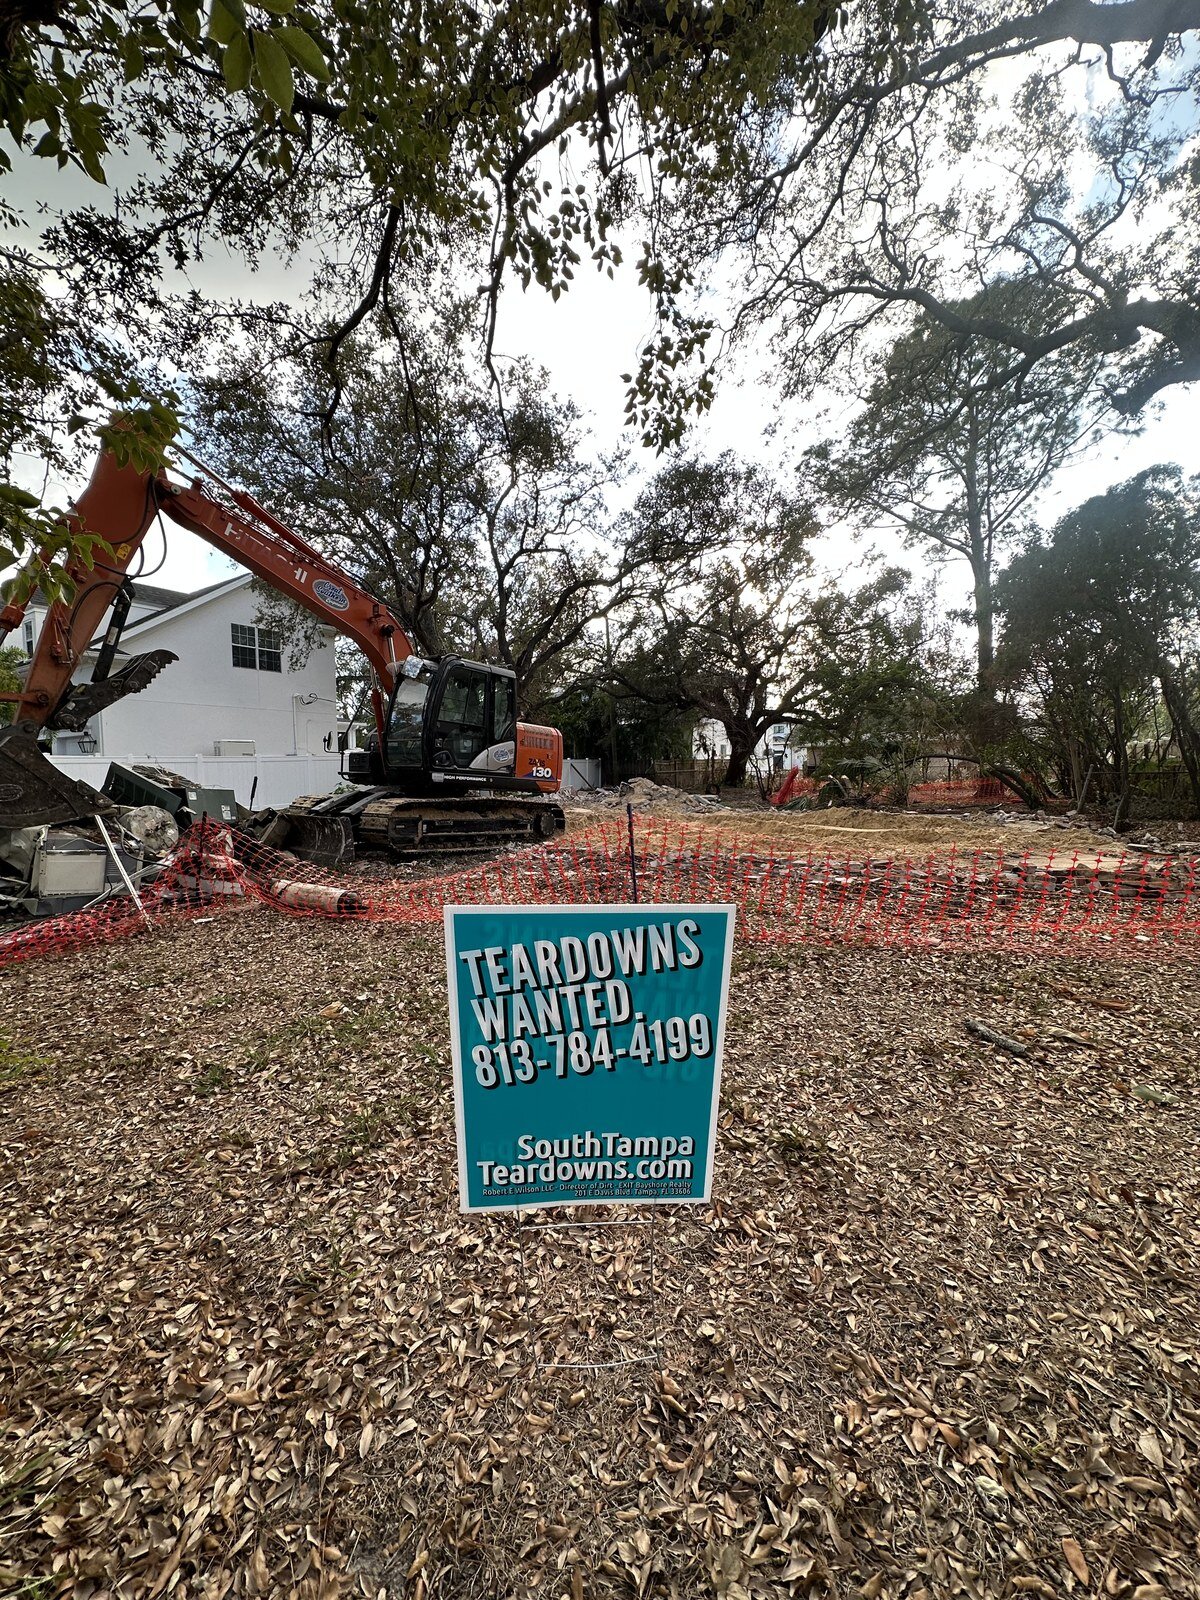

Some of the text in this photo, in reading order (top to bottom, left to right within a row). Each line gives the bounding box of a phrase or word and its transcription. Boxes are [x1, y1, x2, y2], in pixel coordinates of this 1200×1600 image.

[532, 766, 552, 778] 130
[459, 919, 702, 998] TEARDOWNS
[470, 978, 646, 1045] WANTED.
[471, 1013, 712, 1088] 813-784-4199
[517, 1131, 694, 1161] SouthTampa
[477, 1156, 692, 1186] Teardowns.com
[482, 1188, 508, 1196] Robert
[516, 1186, 540, 1194] Wilson
[559, 1183, 588, 1191] Director
[635, 1180, 668, 1190] Bayshore
[669, 1180, 692, 1189] Realty
[574, 1189, 587, 1197] 201
[594, 1188, 614, 1196] Davis
[670, 1186, 691, 1195] 33606
